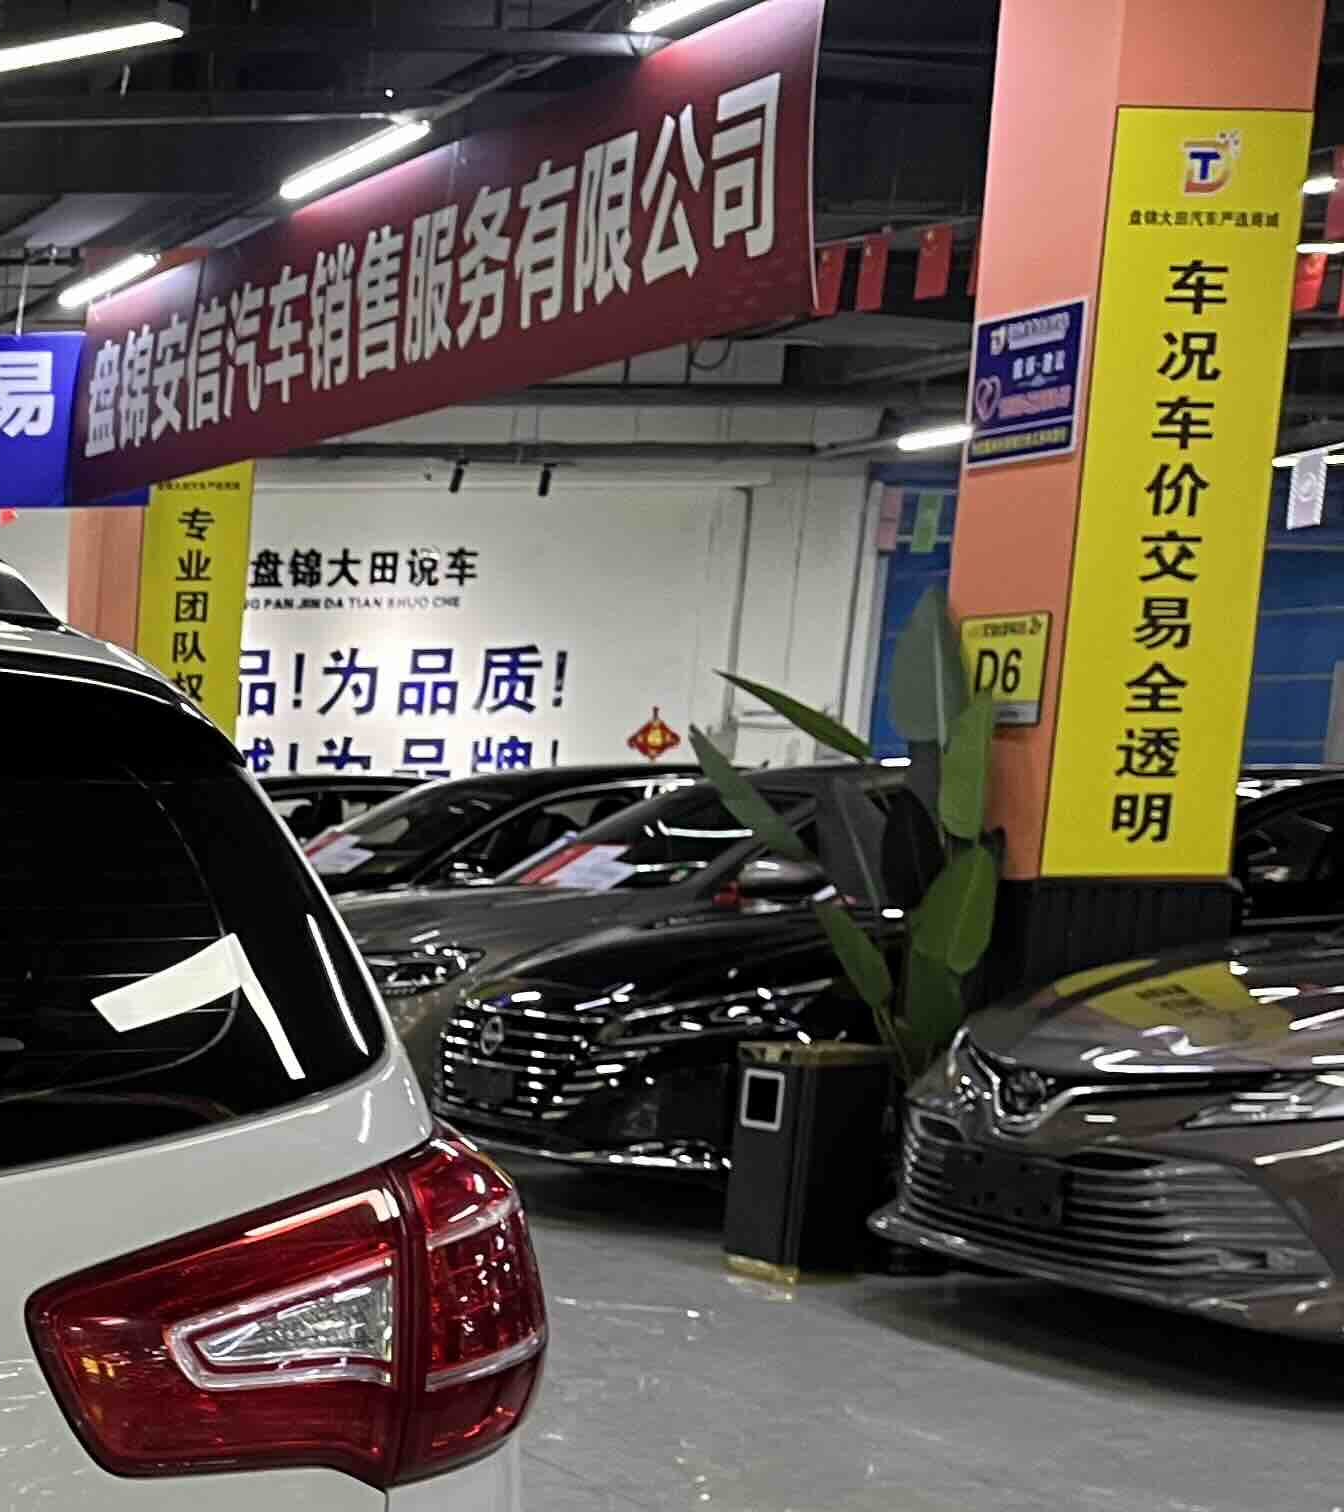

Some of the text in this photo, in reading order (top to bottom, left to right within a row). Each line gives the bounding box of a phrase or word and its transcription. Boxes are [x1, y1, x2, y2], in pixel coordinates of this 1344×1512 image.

[84, 72, 783, 459] 盘锦安信汽车销售服务有限公司
[248, 547, 479, 588] 盘锦大田说车
[1110, 260, 1229, 843] 车况车价交易全透明
[974, 648, 1023, 694] D6
